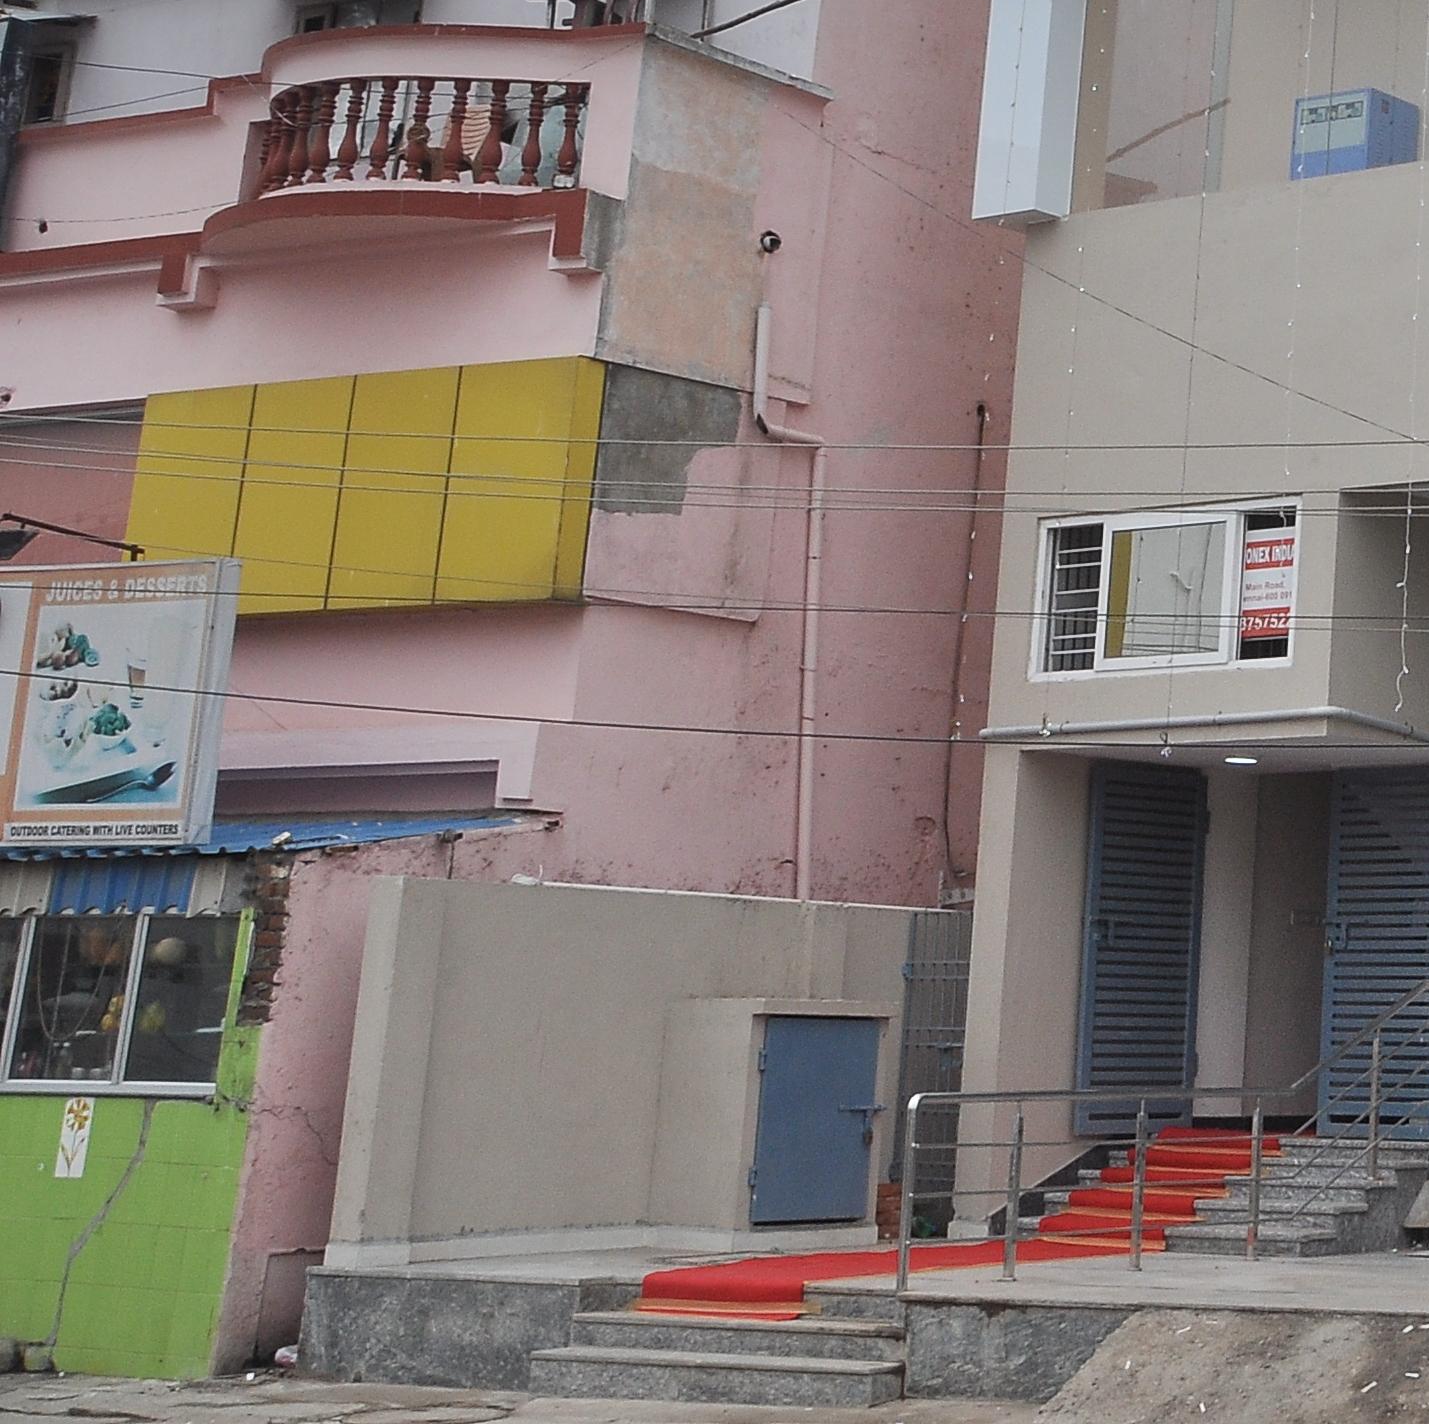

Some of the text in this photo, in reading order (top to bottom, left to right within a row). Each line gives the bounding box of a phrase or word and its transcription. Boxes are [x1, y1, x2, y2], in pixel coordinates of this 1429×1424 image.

[46, 575, 208, 602] JUICES & DESSERTS
[10, 824, 179, 837] OUTDOOR CATERING WITH LIVE COUNTERS
